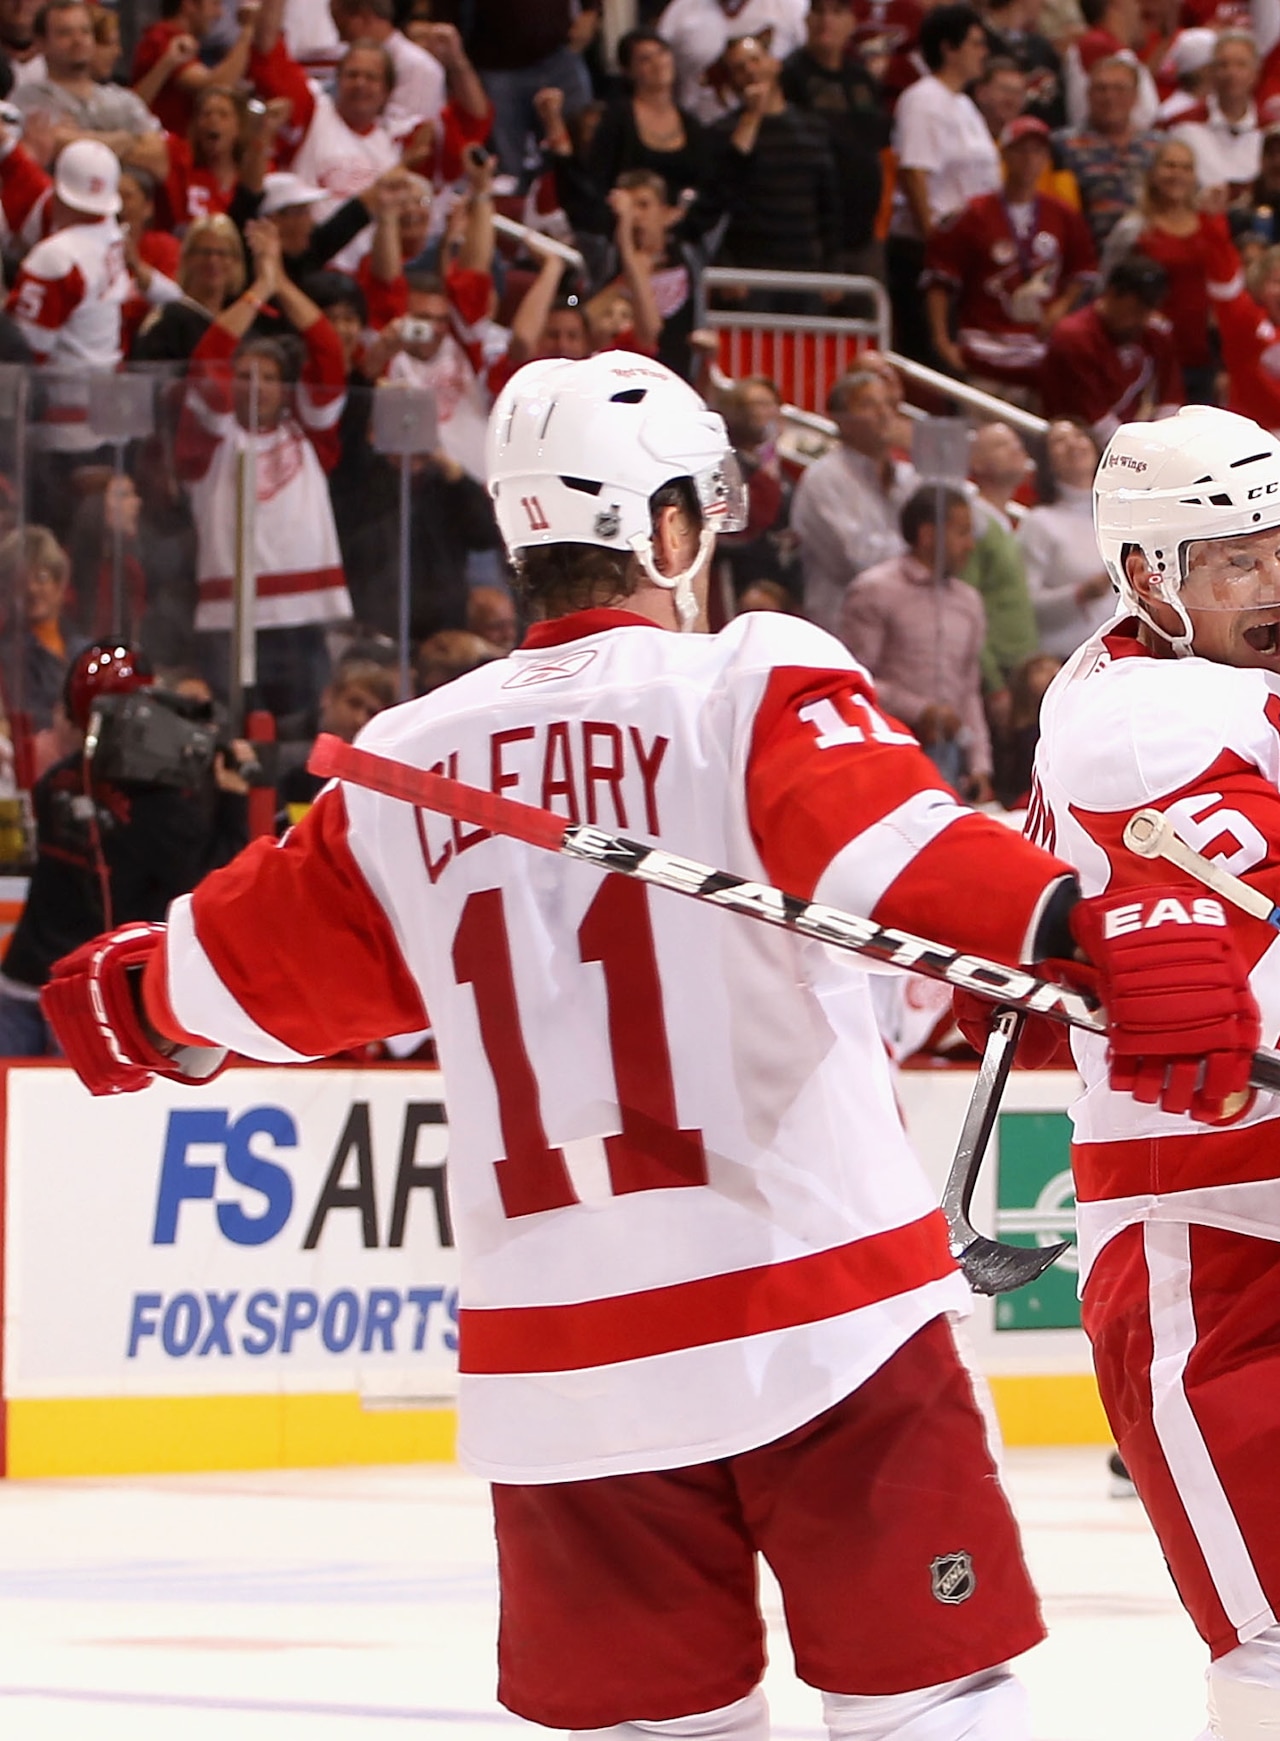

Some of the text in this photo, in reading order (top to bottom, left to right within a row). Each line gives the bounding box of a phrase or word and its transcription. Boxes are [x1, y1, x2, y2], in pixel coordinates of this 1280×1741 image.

[520, 496, 549, 531] 11
[797, 693, 921, 750] 11
[414, 721, 670, 884] CLEARY
[1163, 792, 1268, 877] 5
[634, 850, 1105, 1031] EASTON
[1103, 898, 1227, 940] EAS
[452, 872, 709, 1220] 11
[152, 1101, 455, 1250] FS AR
